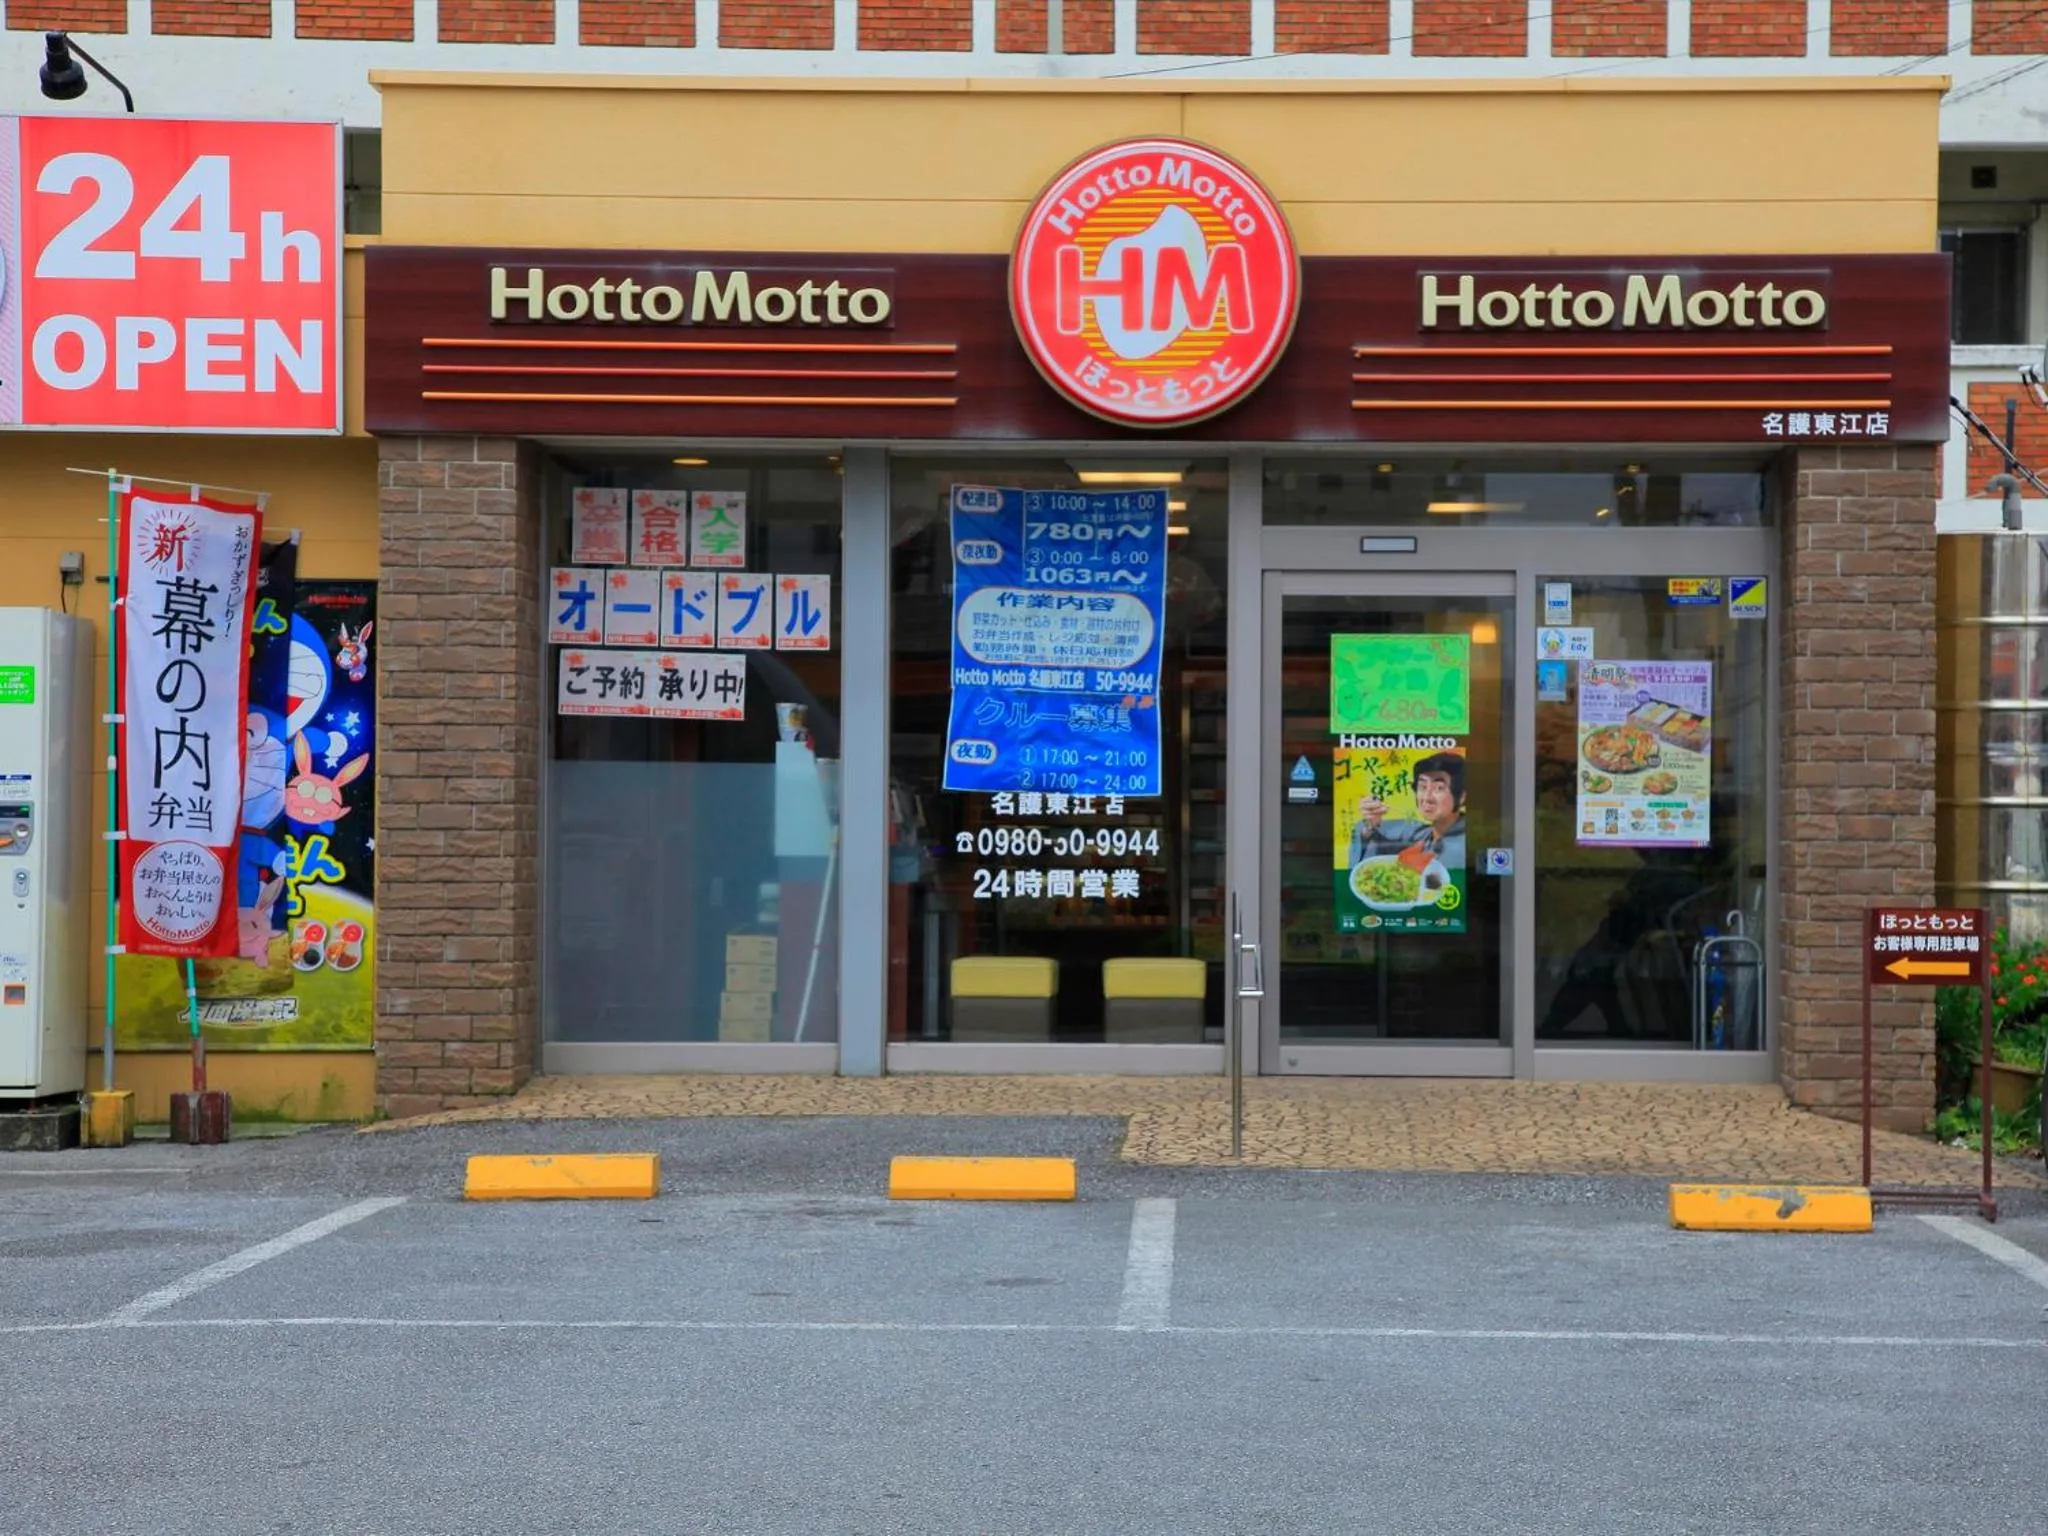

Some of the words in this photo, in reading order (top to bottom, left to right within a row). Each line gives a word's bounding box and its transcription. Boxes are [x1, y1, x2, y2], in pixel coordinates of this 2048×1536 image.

[33, 152, 321, 282] 24h
[1056, 243, 1254, 334] HM
[32, 314, 323, 393] OPEN
[1075, 355, 1241, 406] ほっともっと
[1761, 411, 1889, 437] 名護東江店
[1051, 496, 1086, 510] 10:00
[641, 506, 680, 552] 合格
[700, 506, 740, 553] 入学
[145, 523, 190, 572] 新
[1050, 551, 1082, 565] 0:00
[557, 580, 822, 635] オードブル
[996, 592, 1115, 612] 作業内容
[566, 665, 645, 700] ご予約
[955, 668, 989, 685] Hotto
[992, 669, 1026, 685] Motto
[1096, 671, 1154, 692] 50-9944
[957, 743, 992, 760] 夜勤
[1043, 750, 1079, 766] 17:00
[1105, 751, 1147, 767] 21:00
[1041, 774, 1077, 789] 17:00
[1104, 775, 1146, 790] 24:00
[148, 792, 213, 833] 弁当
[973, 869, 1140, 899] 24時間営業
[1880, 914, 1974, 930] ほっともっと
[1874, 935, 1980, 952] お客様専用駐車場
